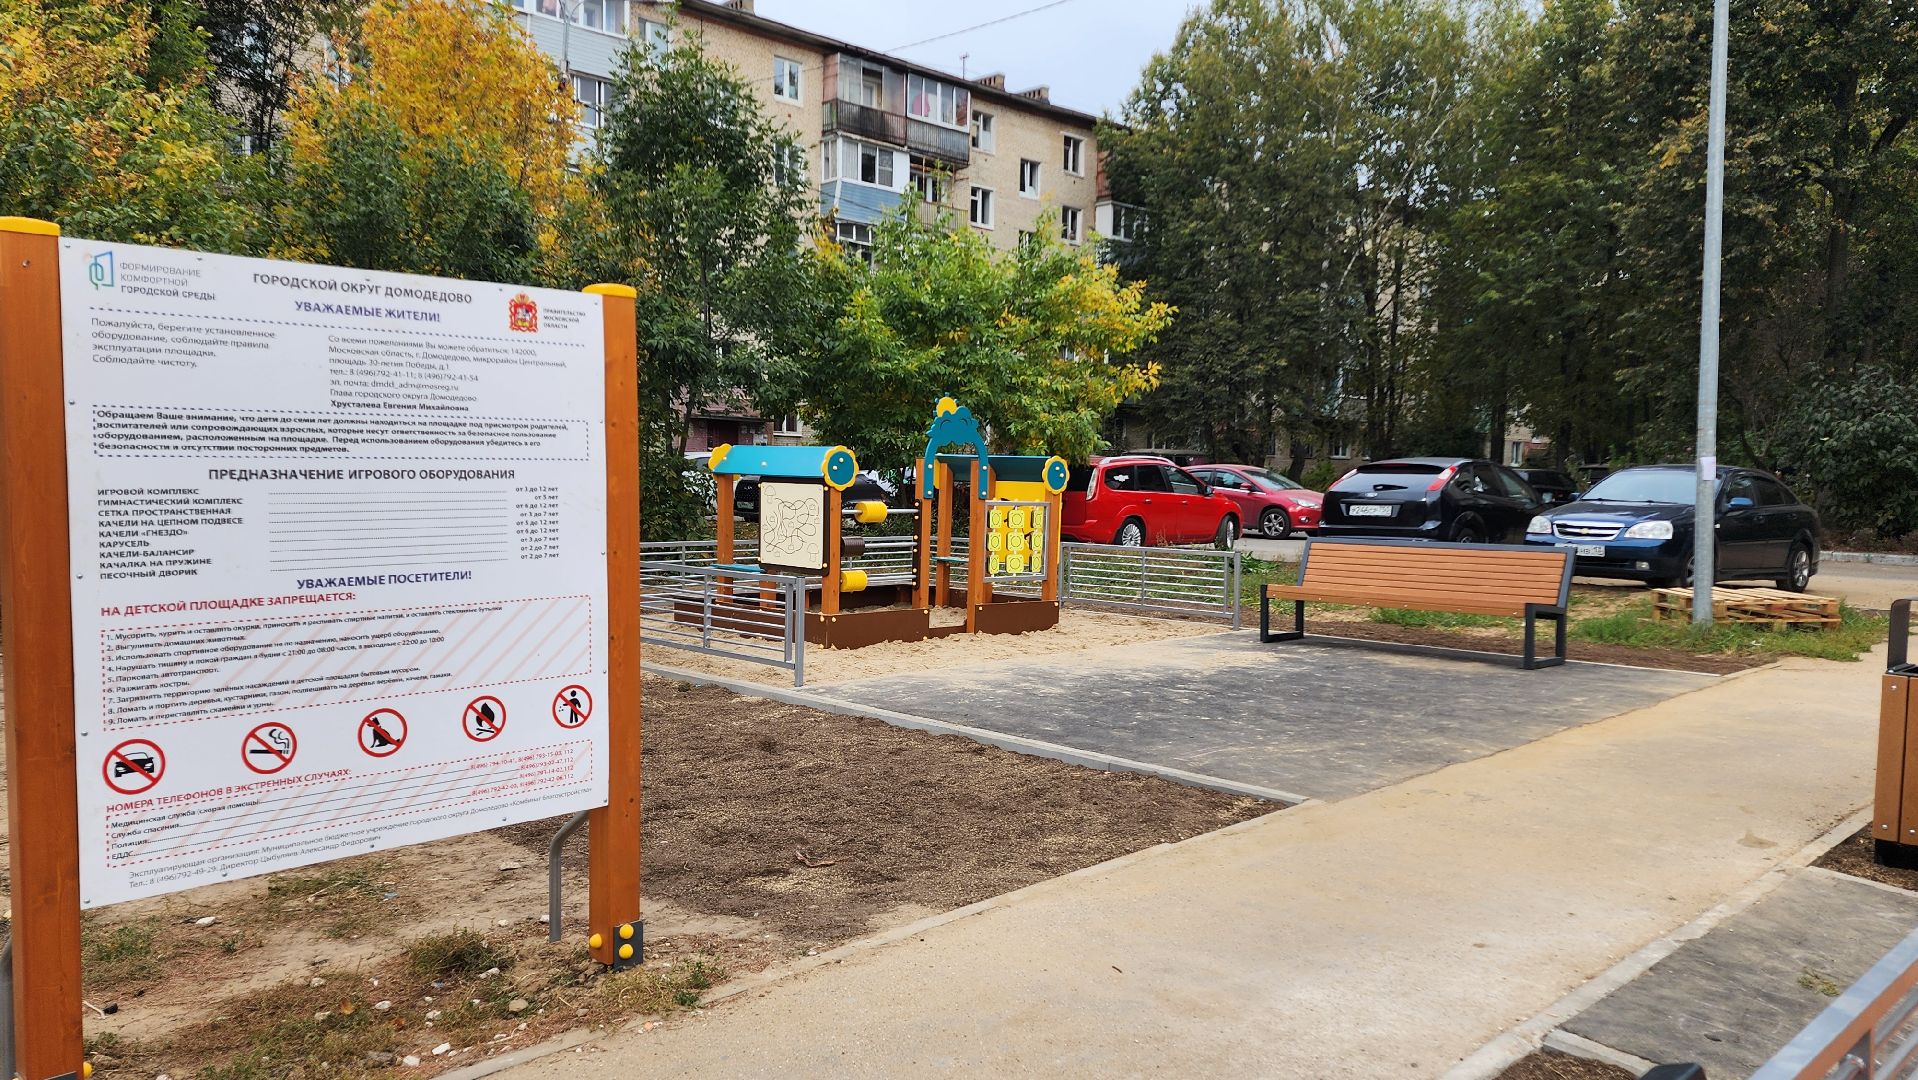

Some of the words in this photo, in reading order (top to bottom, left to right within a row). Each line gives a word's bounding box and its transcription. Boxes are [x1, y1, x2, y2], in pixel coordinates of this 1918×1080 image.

[119, 261, 201, 278] ФОРМИРОВАНИЕ
[120, 272, 188, 287] КОМФОРТНОЙ
[120, 284, 179, 297] ГОРОДСКОЙ
[181, 290, 216, 301] СРЕДЫ
[252, 272, 337, 291] ГОРОДСКОЙ
[340, 281, 382, 295] ОКРУГ
[383, 285, 472, 304] ДОМОДЕДОВО
[294, 300, 382, 318] УВАЖАЕМЫЕ
[384, 307, 440, 323] ЖИТЕЛИ!
[156, 321, 203, 334] берегите
[204, 327, 275, 339] установленное
[92, 343, 162, 354] эксплуатации
[170, 335, 229, 347] соблюдайте
[230, 339, 269, 349] правила
[367, 338, 424, 348] пожеланиями
[437, 343, 466, 352] можете
[91, 353, 156, 365] Соблюдайте
[328, 344, 379, 356] Московская
[380, 348, 414, 359] область,
[421, 350, 471, 363] Домодедово,
[329, 387, 353, 397] Глава
[353, 390, 401, 400] городского
[401, 392, 429, 401] округа
[429, 392, 477, 402] Домодедово
[330, 398, 381, 409] Хрусталева
[382, 400, 417, 410] Евгения
[418, 402, 469, 412] Михайловна
[96, 409, 154, 420] Обращаем
[155, 411, 184, 420] Ваше
[428, 420, 467, 428] площадке
[483, 422, 529, 430] присмотром
[96, 421, 168, 430] воспитателей
[190, 424, 279, 433] сопровождающих
[327, 427, 364, 435] которые
[365, 428, 389, 436] несут
[466, 429, 510, 437] безопасное
[96, 431, 183, 441] оборудованием,
[185, 434, 266, 442] расположенным
[331, 435, 360, 445] Перед
[360, 437, 429, 445] использованием
[429, 437, 485, 446] оборудования
[485, 438, 523, 447] убедитесь
[97, 441, 170, 450] безопасности
[180, 444, 235, 452] отсутствии
[236, 444, 298, 453] посторонних
[208, 468, 344, 482] ПРЕДНАЗНАЧЕНИЕ
[348, 468, 416, 480] ИГРОВОГО
[418, 468, 515, 481] ОБОРУДОВАНИЯ
[96, 487, 144, 496] ИГРОВОЙ
[146, 487, 199, 495] КОМПЛЕКС
[97, 497, 190, 506] ГИМНАСТИЧЕСКИЙ
[192, 497, 243, 505] КОМПЛЕКС
[97, 509, 129, 517] СЕТКА
[131, 507, 231, 517] ПРОСТРАНСТВЕННАЯ
[98, 519, 139, 528] КАЧЕЛИ
[156, 517, 199, 527] ЦЕПНОМ
[200, 516, 243, 526] ПОДВЕСЕ
[98, 529, 139, 538] КАЧЕЛИ
[98, 539, 150, 549] КАРУСЕЛЬ
[99, 548, 195, 559] КАЧЕЛИ-БАЛАНСИР
[99, 560, 147, 569] КАЧАЛКА
[164, 557, 212, 566] ПРУЖИНЕ
[99, 569, 156, 580] ПЕСОЧНЫЙ
[157, 568, 198, 578] ДВОРИК
[296, 574, 386, 590] УВАЖАЕМЫЕ
[387, 569, 472, 585] ПОСЕТИТЕЛИ!
[100, 606, 121, 617] НА
[123, 599, 187, 617] ДЕТСКОЙ
[189, 596, 265, 611] ПЛОЩАДКЕ
[266, 591, 356, 606] ЗАПРЕЩАЕТСЯ:
[114, 642, 163, 651] Выгуливать
[163, 638, 205, 648] домашних
[115, 672, 160, 682] Парковать
[115, 683, 158, 693] Разжигать
[105, 798, 154, 813] НОМЕРА
[155, 787, 223, 803] ТЕЛЕФОНОВ
[233, 775, 303, 791] ЭКСТРЕННЫХ
[110, 814, 166, 829] Медицинская
[167, 809, 196, 820] служба
[110, 828, 142, 839] Служба
